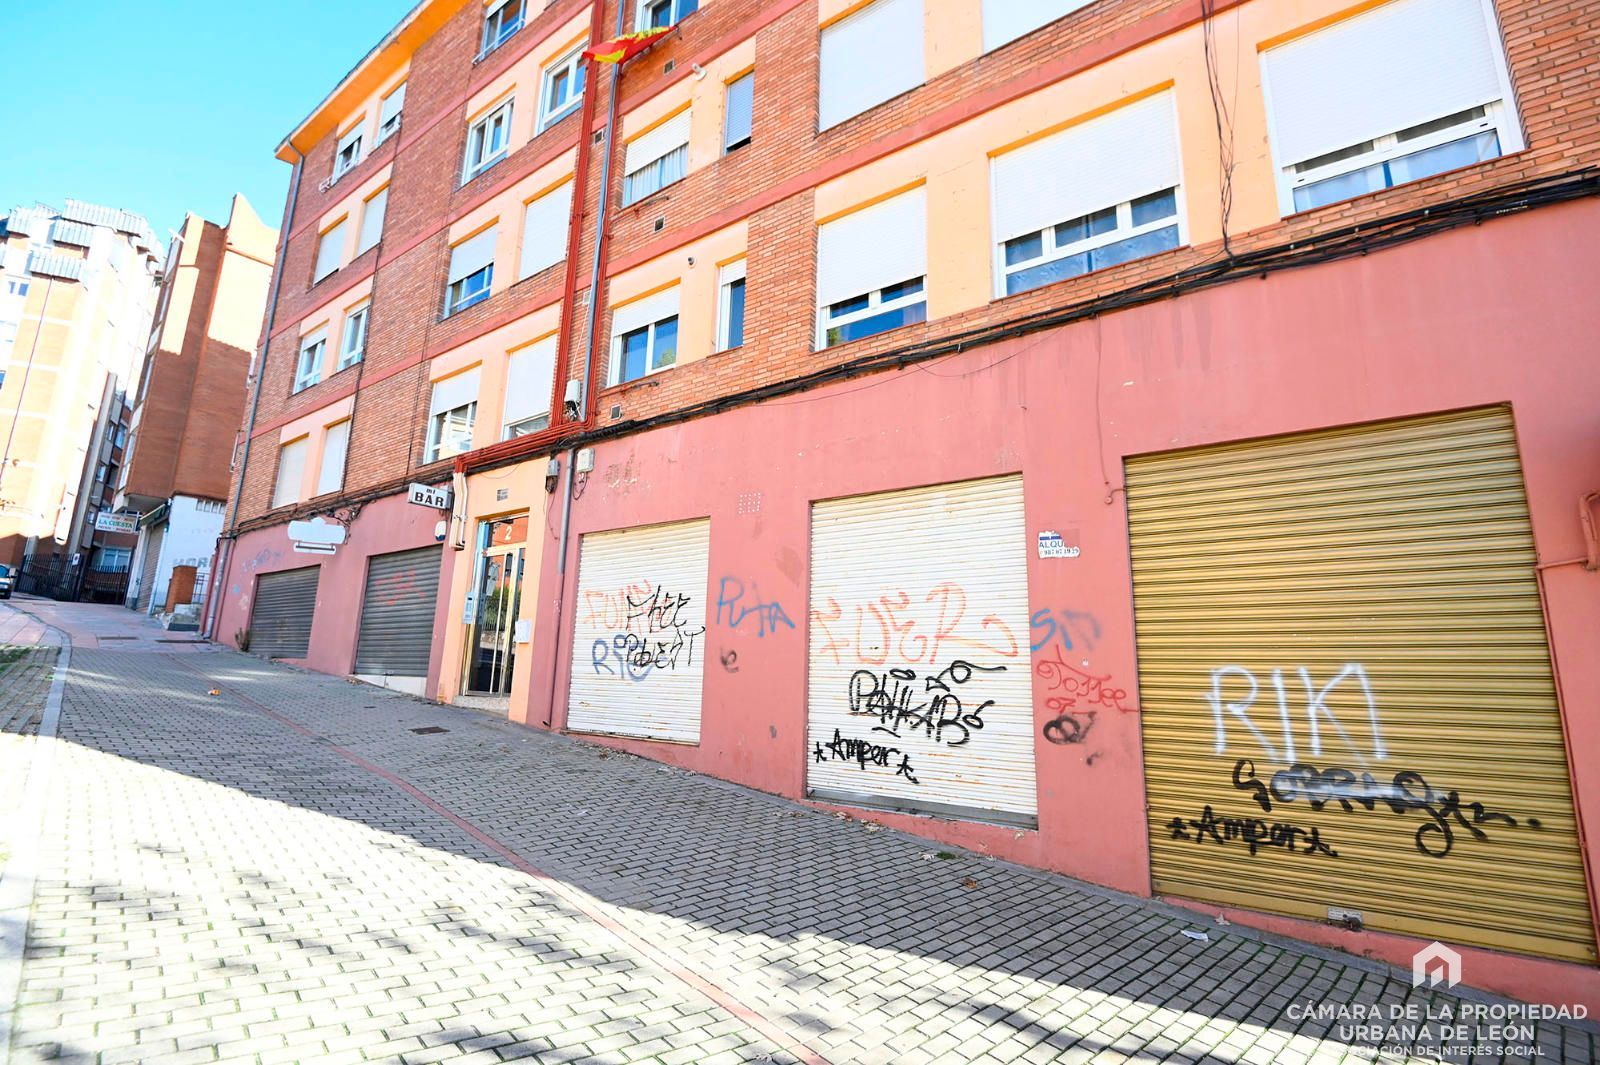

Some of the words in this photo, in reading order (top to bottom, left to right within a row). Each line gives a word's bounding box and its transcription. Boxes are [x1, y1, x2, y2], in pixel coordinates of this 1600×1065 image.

[415, 491, 444, 507] BAR
[109, 520, 132, 528] CUESTA
[504, 524, 512, 542] 2
[717, 576, 796, 638] PUTA
